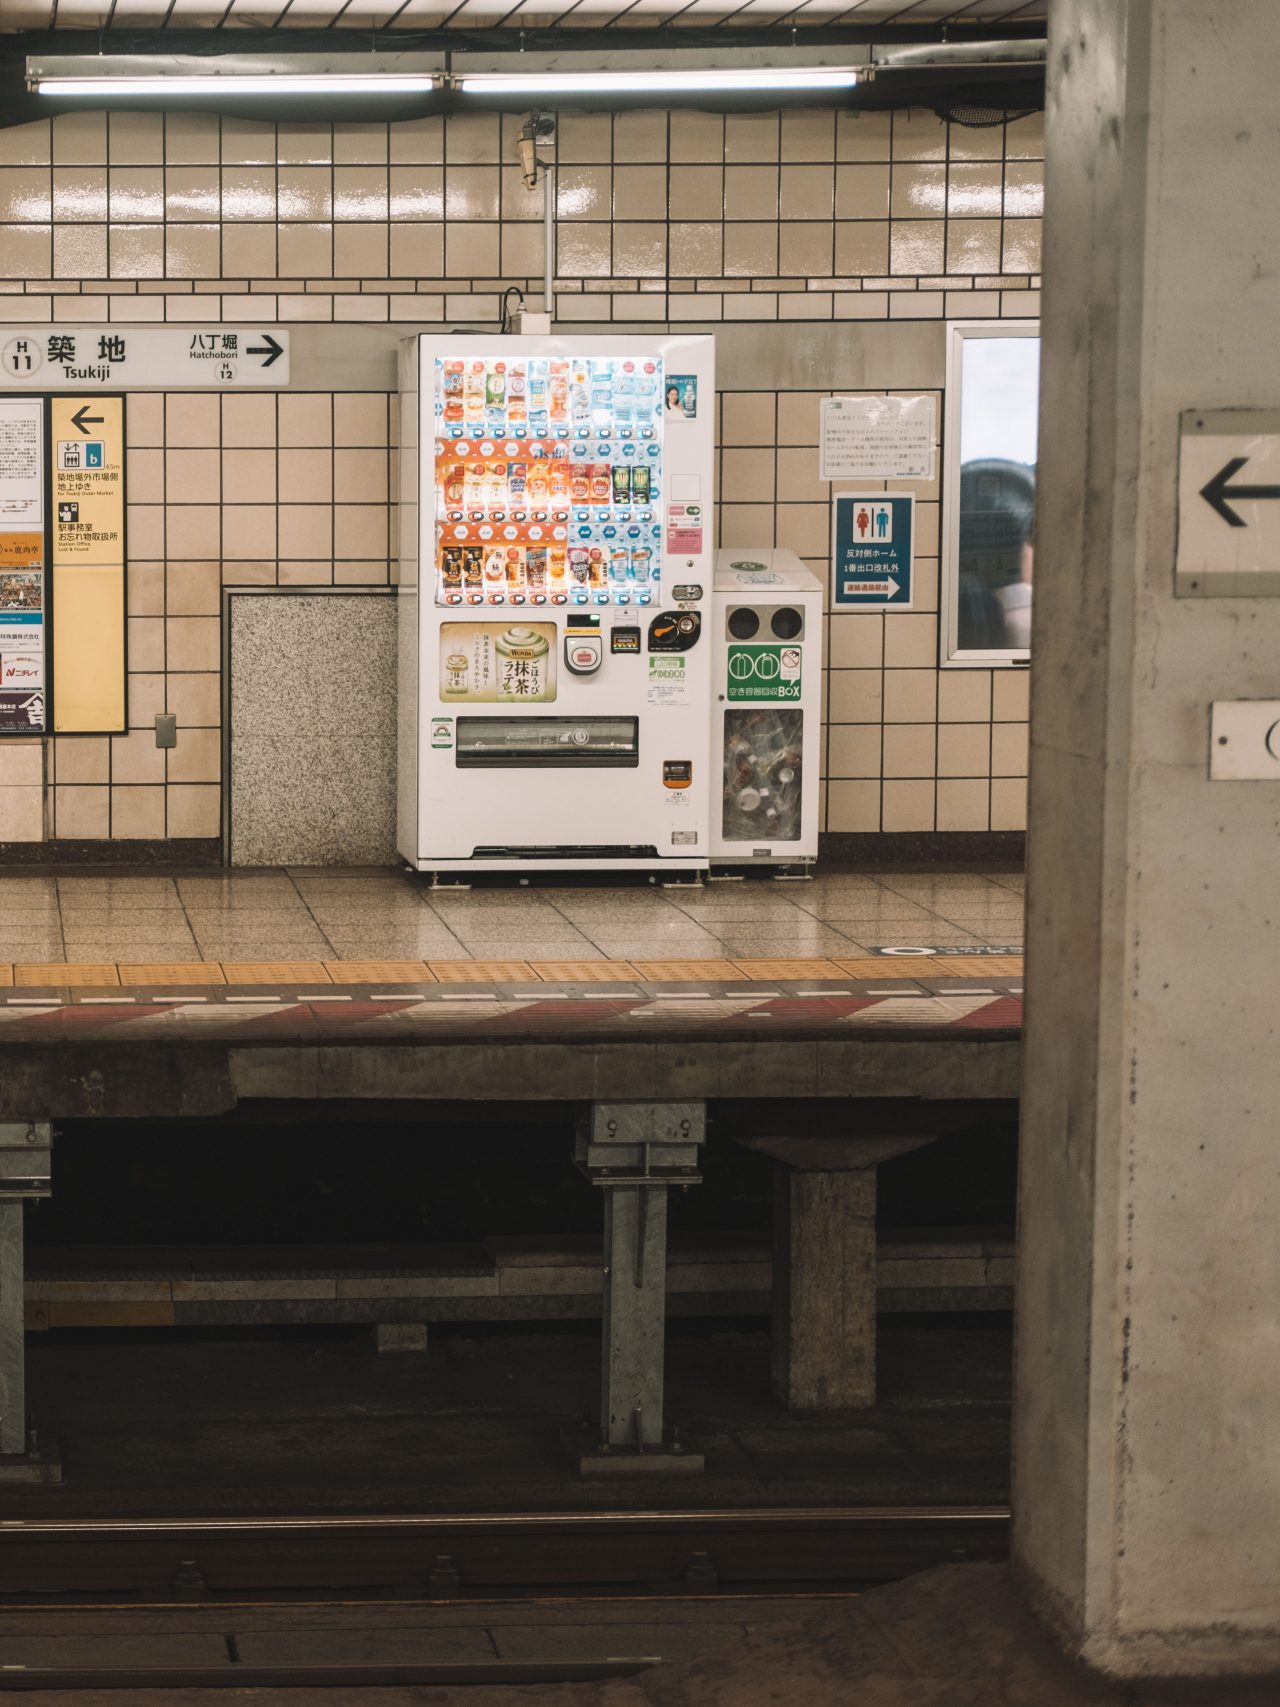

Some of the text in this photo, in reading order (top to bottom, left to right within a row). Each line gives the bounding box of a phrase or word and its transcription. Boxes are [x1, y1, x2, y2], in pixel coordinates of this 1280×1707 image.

[190, 334, 238, 350] 八丁堀
[17, 342, 27, 353] H
[190, 351, 238, 359] Hatchobori
[13, 356, 32, 370] 11
[62, 365, 110, 382] Tsukiji
[220, 370, 233, 379] 12
[90, 454, 97, 464] b
[57, 473, 118, 481] 築地場外市場側
[57, 483, 91, 491] 地上ゆき
[58, 523, 93, 532] 駅事務室
[58, 532, 118, 541] お忘れ物取扱所
[846, 549, 897, 558] 反対側ホーム
[844, 564, 900, 573] 1番出口改札外
[511, 649, 532, 657] WONDA
[515, 660, 530, 695] 抹茶
[531, 660, 540, 694] ごほうび
